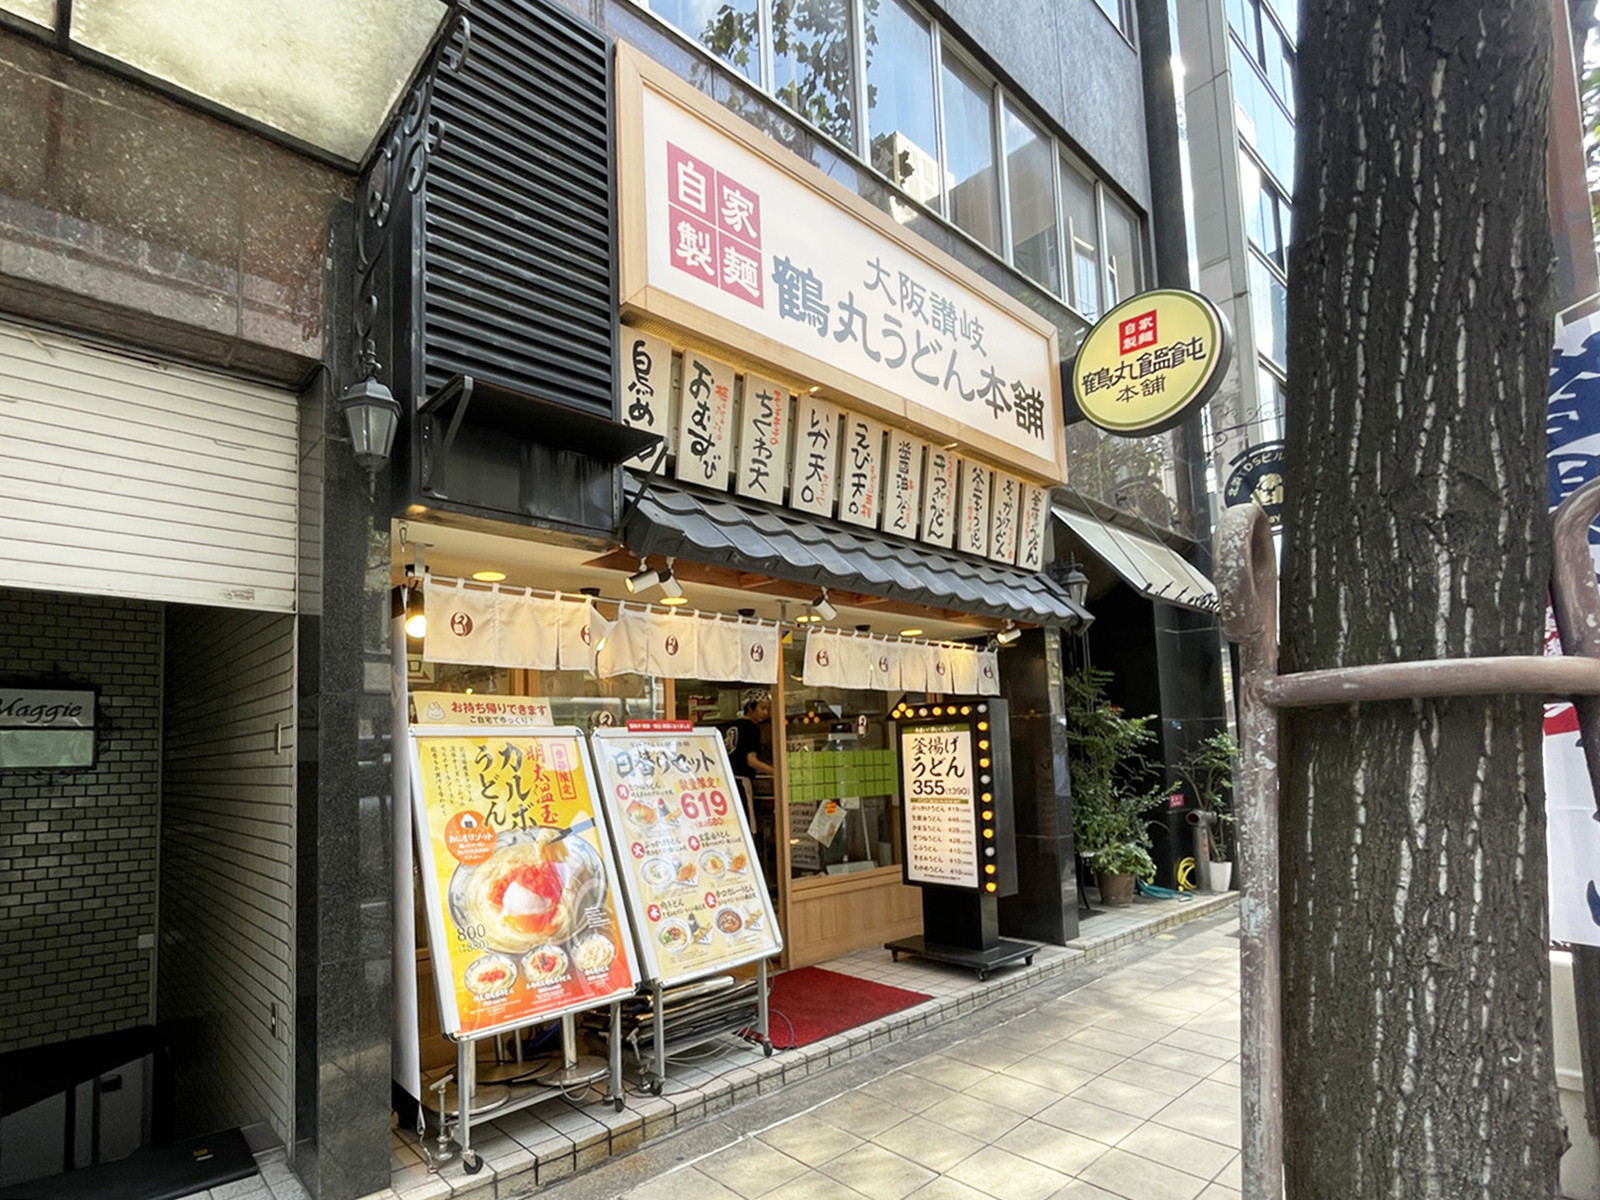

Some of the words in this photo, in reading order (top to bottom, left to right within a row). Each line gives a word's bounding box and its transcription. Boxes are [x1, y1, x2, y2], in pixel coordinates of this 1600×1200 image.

[676, 160, 758, 239] 自家
[863, 256, 988, 358] 大阪讃岐
[771, 254, 1045, 441] 鶴丸うどん本舗
[1081, 336, 1207, 397] 鶴丸饂飩
[1115, 373, 1167, 404] 本舗
[687, 359, 722, 480] おむすび
[748, 388, 774, 494] ちくわ天
[451, 701, 547, 716] お持ち帰りできます
[613, 748, 716, 778] 日替りセット
[911, 736, 959, 756] 釜揚げ
[911, 755, 966, 779] うどん
[474, 745, 507, 827] うどん
[498, 742, 538, 832] カルボ
[526, 743, 559, 824] 明太温玉
[680, 789, 728, 820] 619
[912, 779, 945, 796] 355
[456, 923, 487, 942] 800
